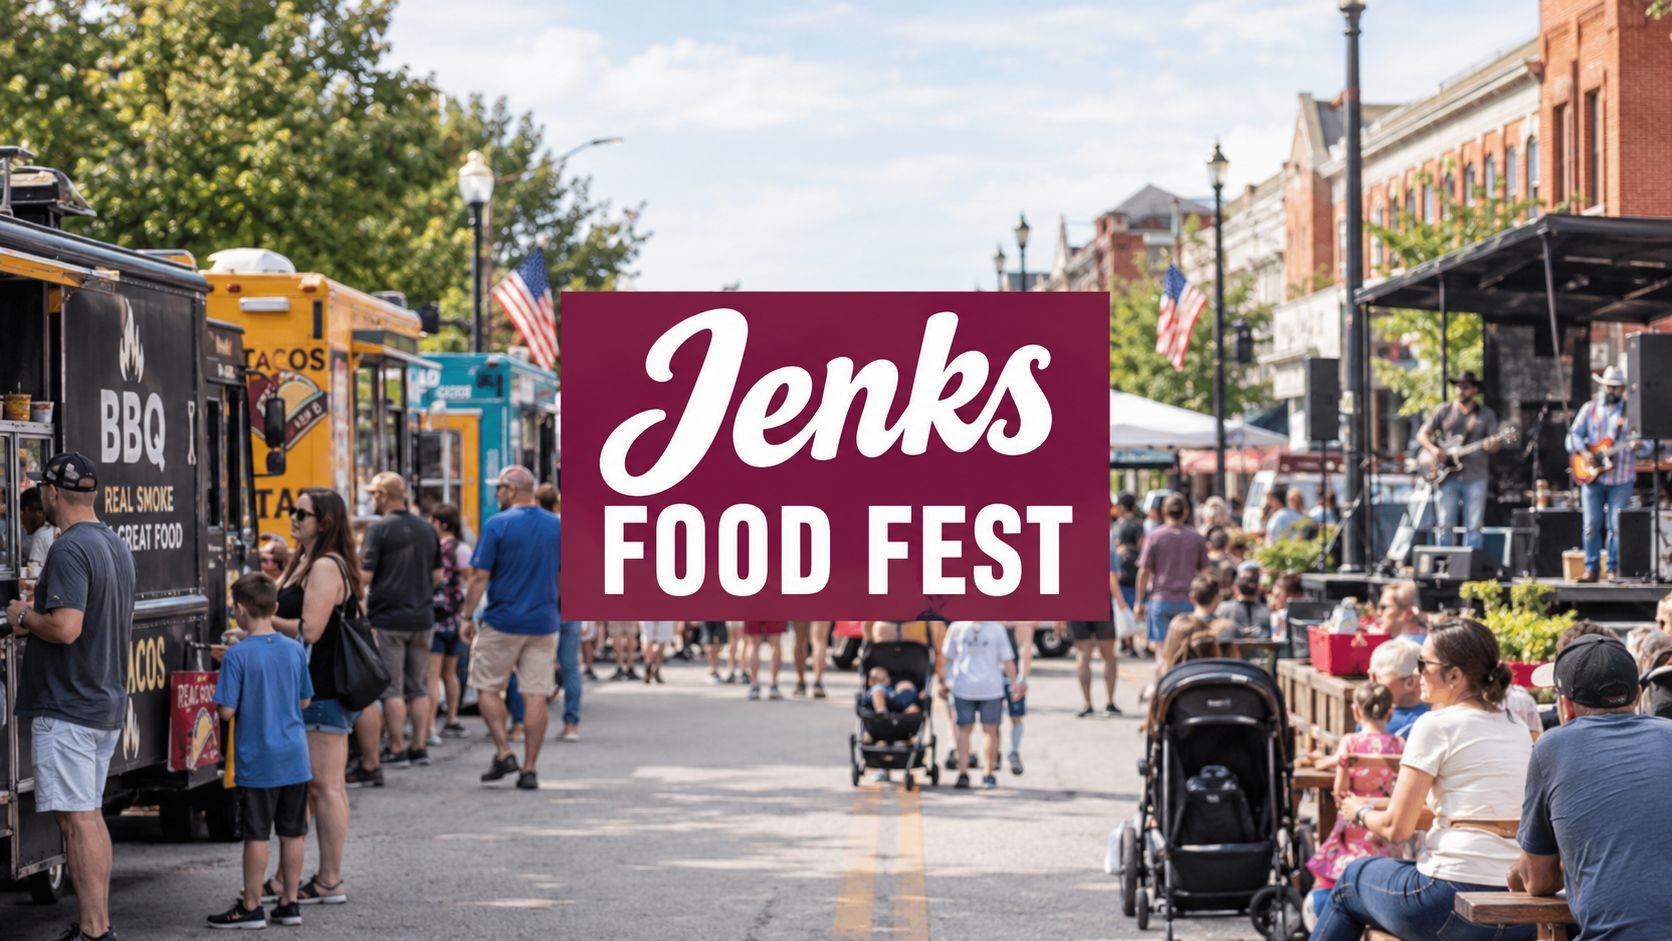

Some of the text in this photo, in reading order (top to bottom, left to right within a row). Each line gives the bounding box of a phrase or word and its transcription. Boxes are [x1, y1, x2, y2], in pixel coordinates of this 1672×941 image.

[243, 347, 326, 371] TACOS
[101, 389, 166, 472] BBQ
[104, 485, 174, 513] REAL SMOKE
[255, 488, 296, 519] TA
[117, 522, 183, 551] GREAT FOOD
[127, 636, 166, 694] ACOS
